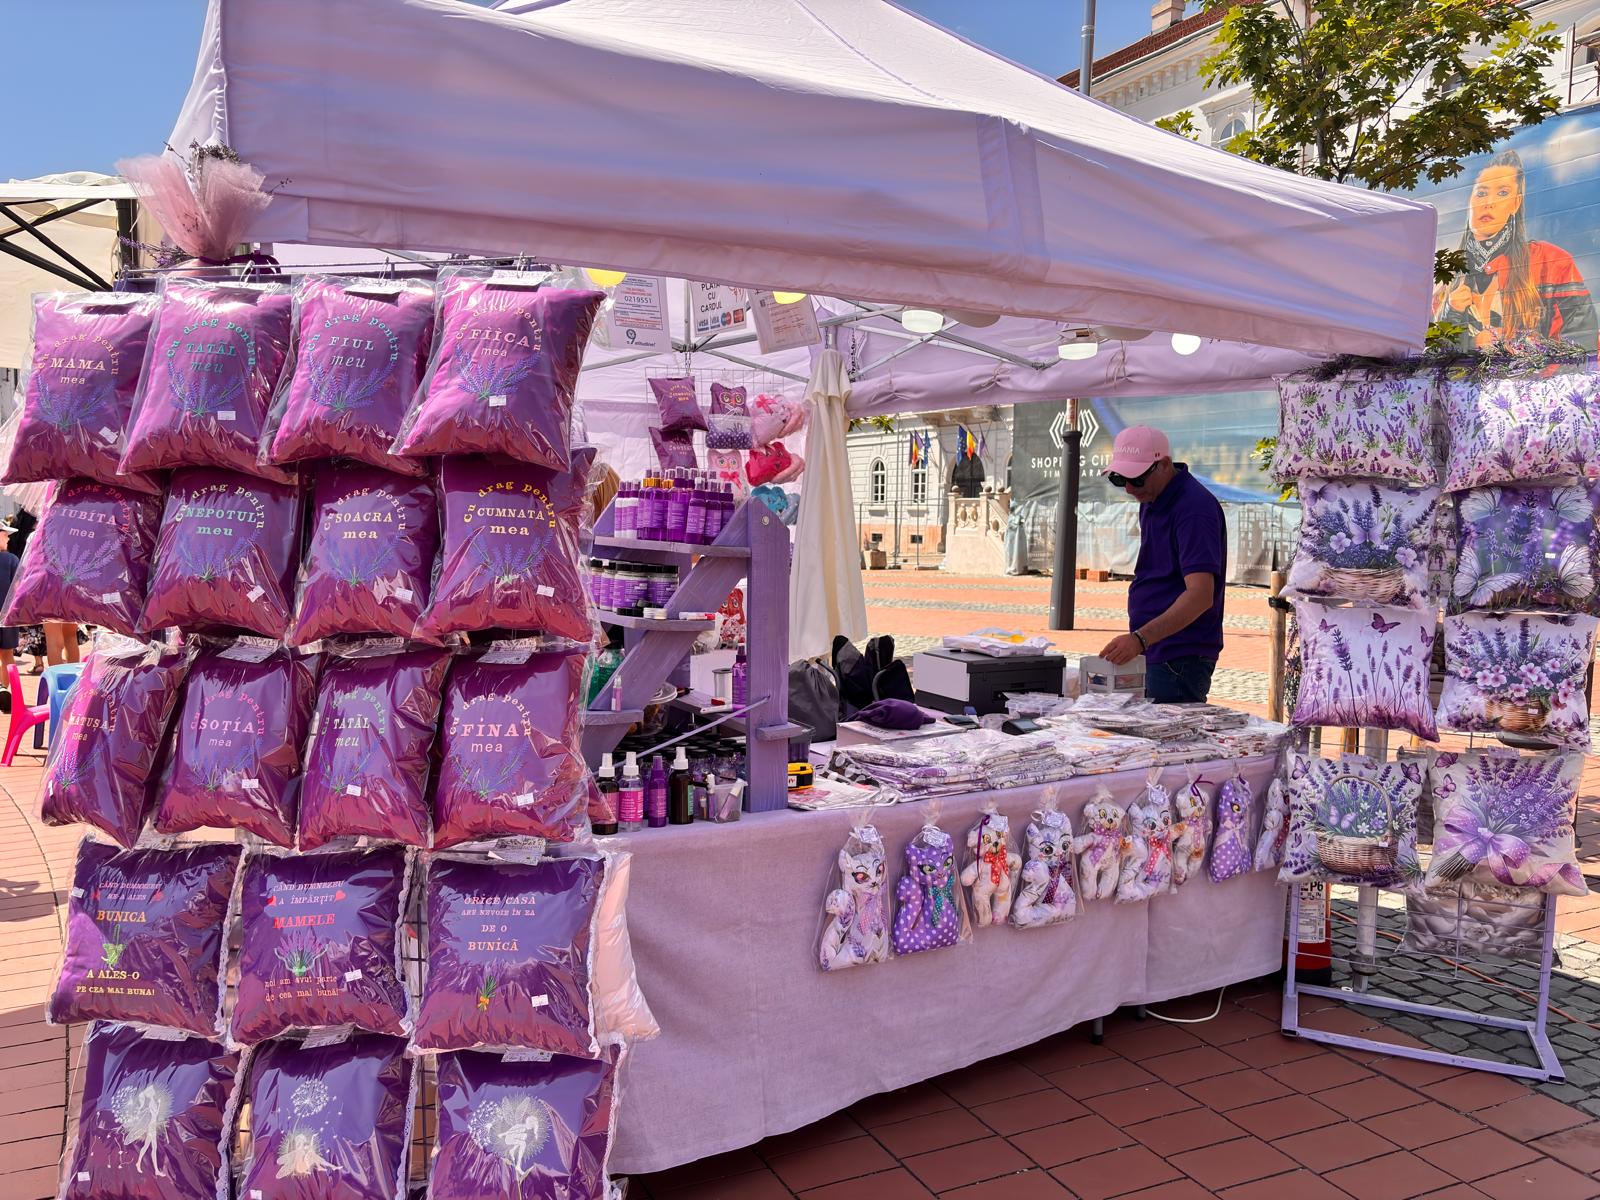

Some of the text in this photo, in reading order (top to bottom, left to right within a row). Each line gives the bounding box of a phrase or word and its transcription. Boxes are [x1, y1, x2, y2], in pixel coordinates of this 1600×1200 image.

[707, 292, 716, 301] CU
[700, 301, 723, 313] CARDUL
[225, 321, 256, 367] pentru
[328, 336, 374, 351] FIUL
[368, 316, 400, 362] pentru
[92, 335, 120, 376] pentru
[480, 347, 508, 357] mea
[50, 357, 106, 371] MAMA
[191, 361, 224, 374] meu
[331, 355, 367, 369] meu
[60, 375, 86, 385] mea
[1091, 453, 1113, 467] CIT
[192, 484, 229, 499] drag
[234, 486, 265, 529] pentru
[337, 487, 371, 506] drag
[376, 488, 407, 531] pentru
[478, 481, 515, 498] drag
[521, 483, 556, 529] pentru
[185, 507, 258, 524] NEPOTUL
[335, 511, 393, 524] SOACRA
[476, 507, 545, 521] CUMNATA
[69, 527, 96, 539] mea
[196, 526, 234, 537] meu
[342, 530, 379, 540] mea
[489, 525, 530, 536] mea
[239, 692, 265, 736] pentru
[463, 693, 496, 710] drag
[502, 694, 532, 737] pentru
[208, 738, 232, 747] mea
[334, 737, 360, 748] meu
[470, 743, 504, 753] mea
[278, 897, 285, 905] A
[96, 910, 146, 923] BUNICA
[272, 913, 337, 929] MAMELE
[481, 924, 508, 933] DE O
[86, 969, 140, 980] A ALES-O
[89, 986, 104, 994] CEA
